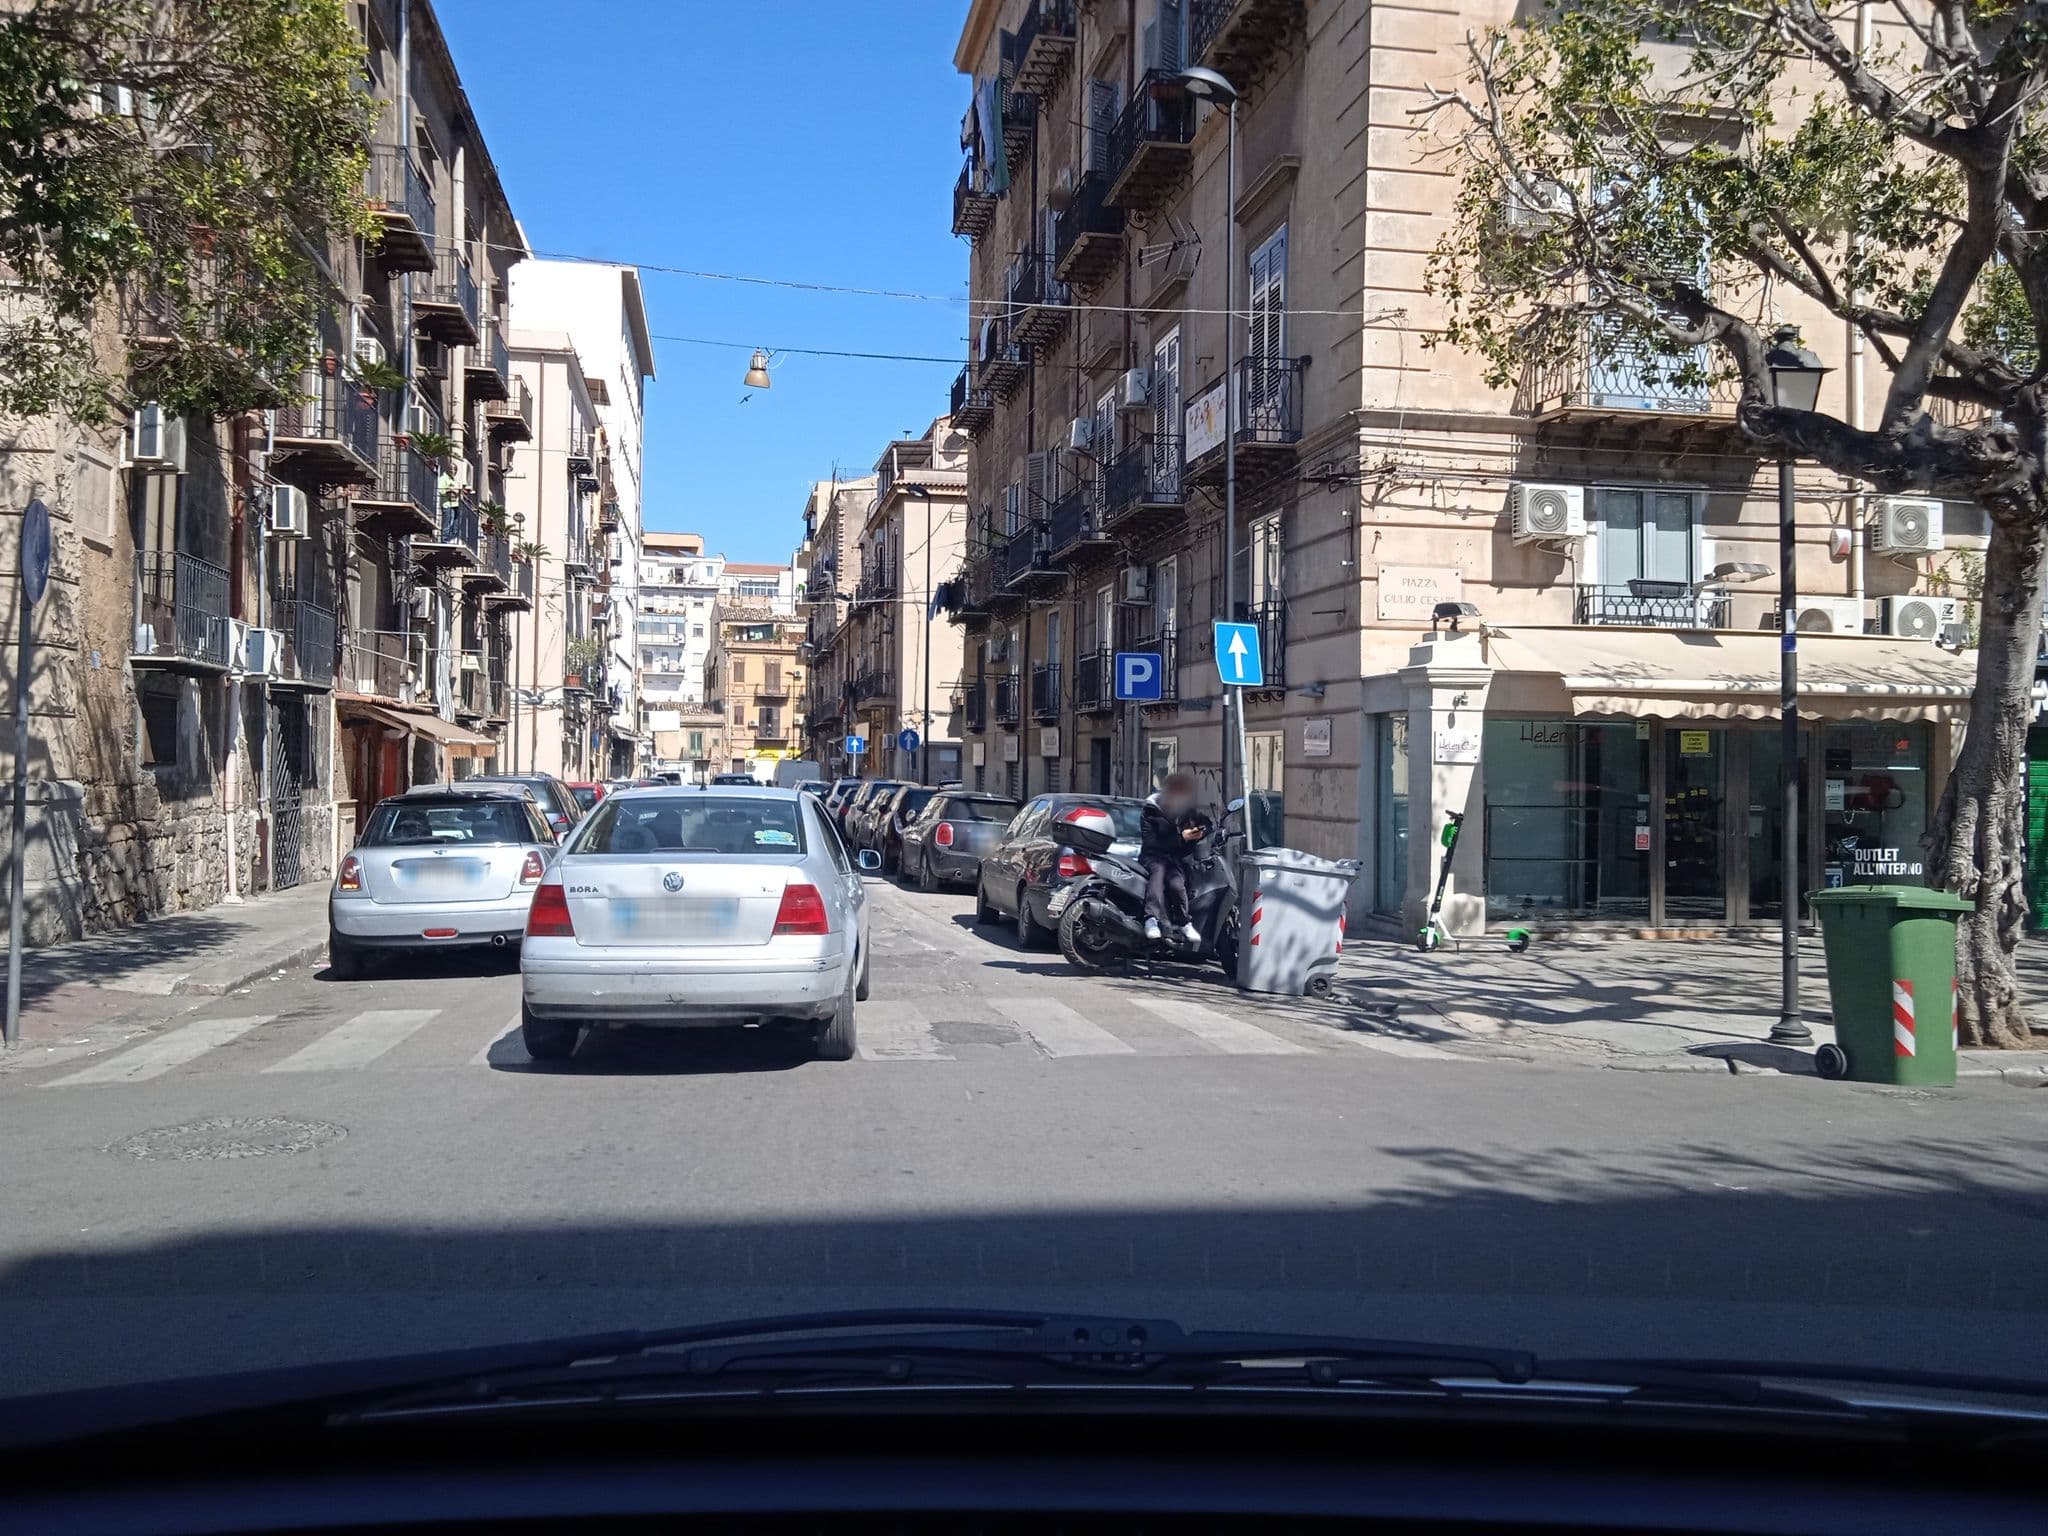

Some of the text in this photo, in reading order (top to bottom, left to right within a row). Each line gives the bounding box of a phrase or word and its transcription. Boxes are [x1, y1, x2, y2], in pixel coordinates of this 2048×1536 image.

[1402, 578, 1437, 588] PIAZZA
[1384, 594, 1416, 604] GIULIO
[1124, 657, 1153, 695] P
[1855, 848, 1899, 861] OUTLET
[1853, 863, 1923, 876] ALL'INTERNO
